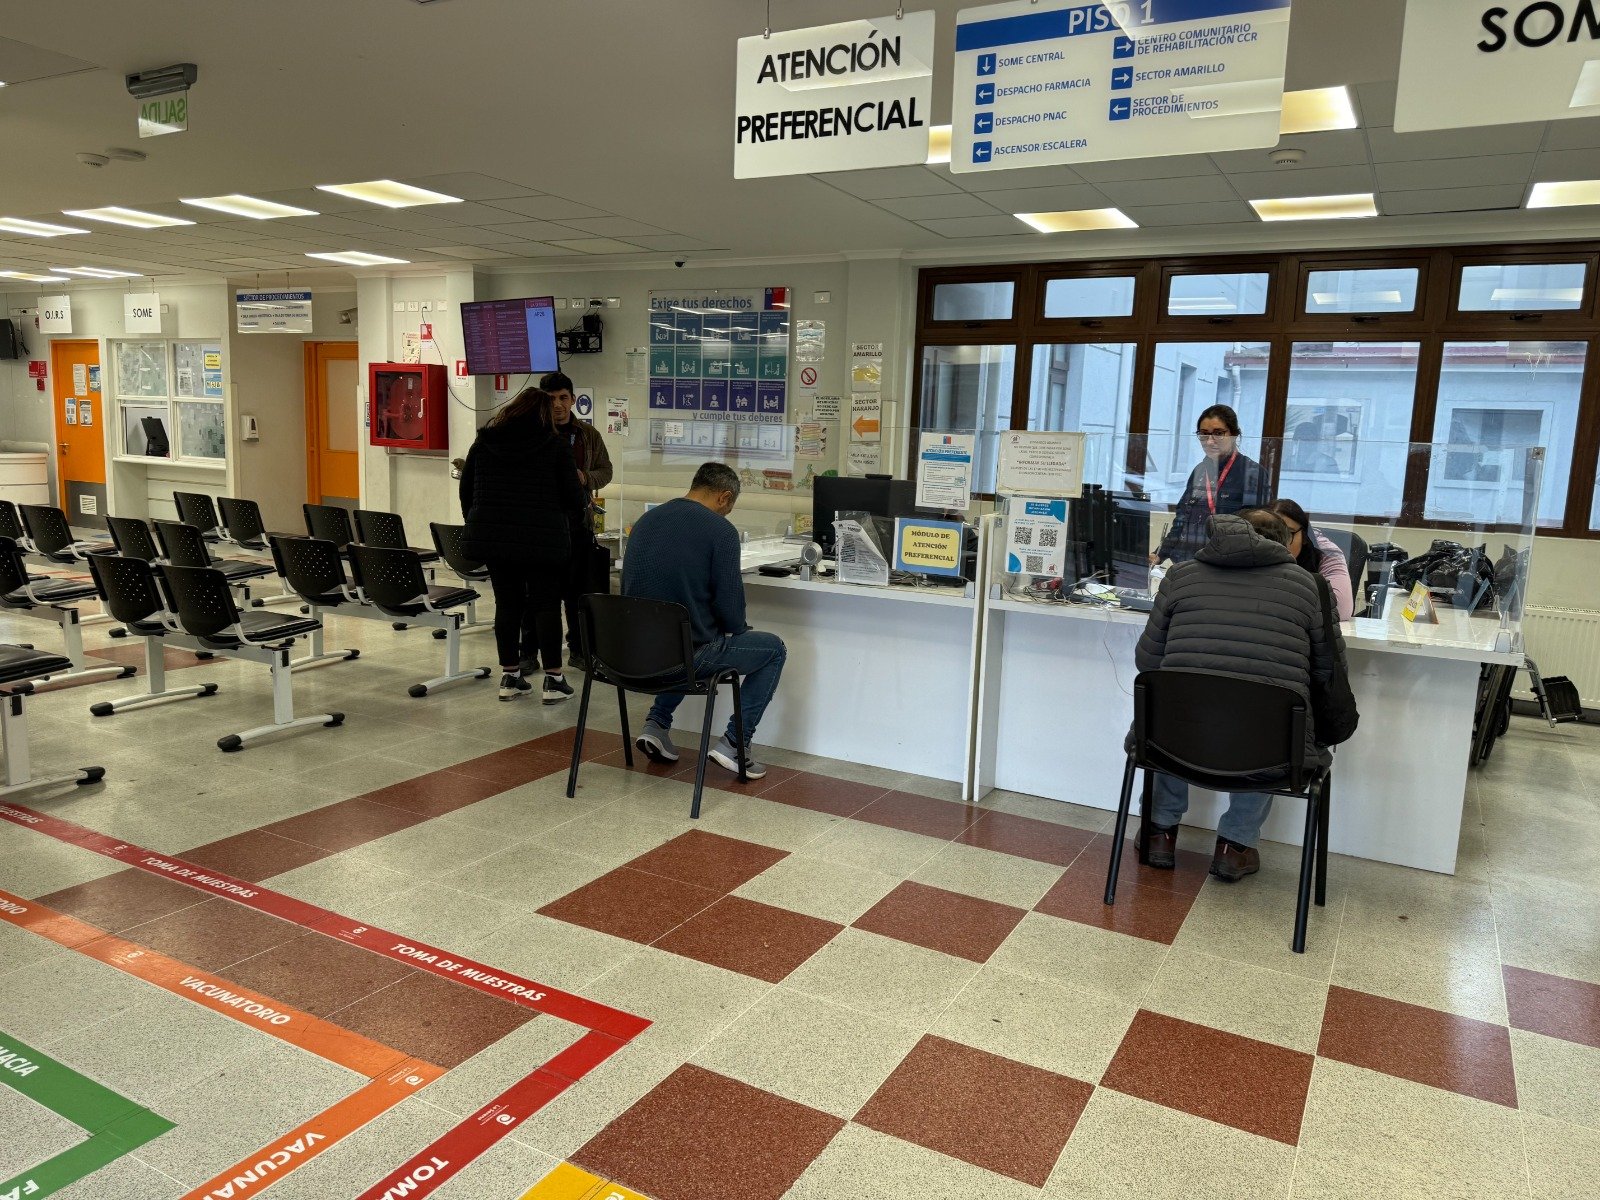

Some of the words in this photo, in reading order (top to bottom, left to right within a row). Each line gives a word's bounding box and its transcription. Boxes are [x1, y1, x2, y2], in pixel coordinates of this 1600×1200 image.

[1068, 3, 1130, 34] PISO
[1140, 0, 1155, 24] 1
[1137, 45, 1150, 55] DE
[1152, 35, 1235, 54] REHABILITACIÓN
[1237, 32, 1258, 43] CCR
[1138, 32, 1177, 46] CENTRO
[1178, 23, 1251, 41] COMUNITARIO
[757, 29, 901, 84] ATENCIÓN
[998, 56, 1024, 68] SOME
[1025, 51, 1066, 64] CENTRAL
[1135, 69, 1175, 82] SECTOR
[1173, 62, 1225, 77] AMARILLO
[996, 83, 1043, 97] DESPACHO
[1044, 78, 1091, 92] FARMACIA
[1132, 95, 1169, 108] SECTOR
[1171, 94, 1185, 104] DE
[1132, 100, 1219, 117] PROCEDIMIENTOS
[736, 96, 924, 144] PREFERENCIAL
[995, 113, 1041, 126] DESPACHO
[1043, 111, 1068, 121] PNAC
[651, 297, 679, 311] Exige
[682, 298, 699, 309] tus
[701, 296, 752, 309] derechos
[132, 308, 153, 318] SOME
[692, 412, 698, 420] y
[699, 411, 731, 421] cumple
[733, 413, 746, 421] tus
[748, 413, 783, 423] deberes
[911, 529, 939, 539] MÓDULO
[912, 541, 948, 550] ATENCIÓN
[904, 551, 955, 562] PREFERENCIAL
[140, 857, 180, 872] TOMA
[174, 868, 198, 878] DE
[190, 874, 259, 898] MUESTRAS
[390, 943, 440, 964] TOMA
[435, 959, 464, 972] DE
[458, 968, 547, 1002] MUESTRAS
[179, 975, 291, 1026] VACUNATORIO
